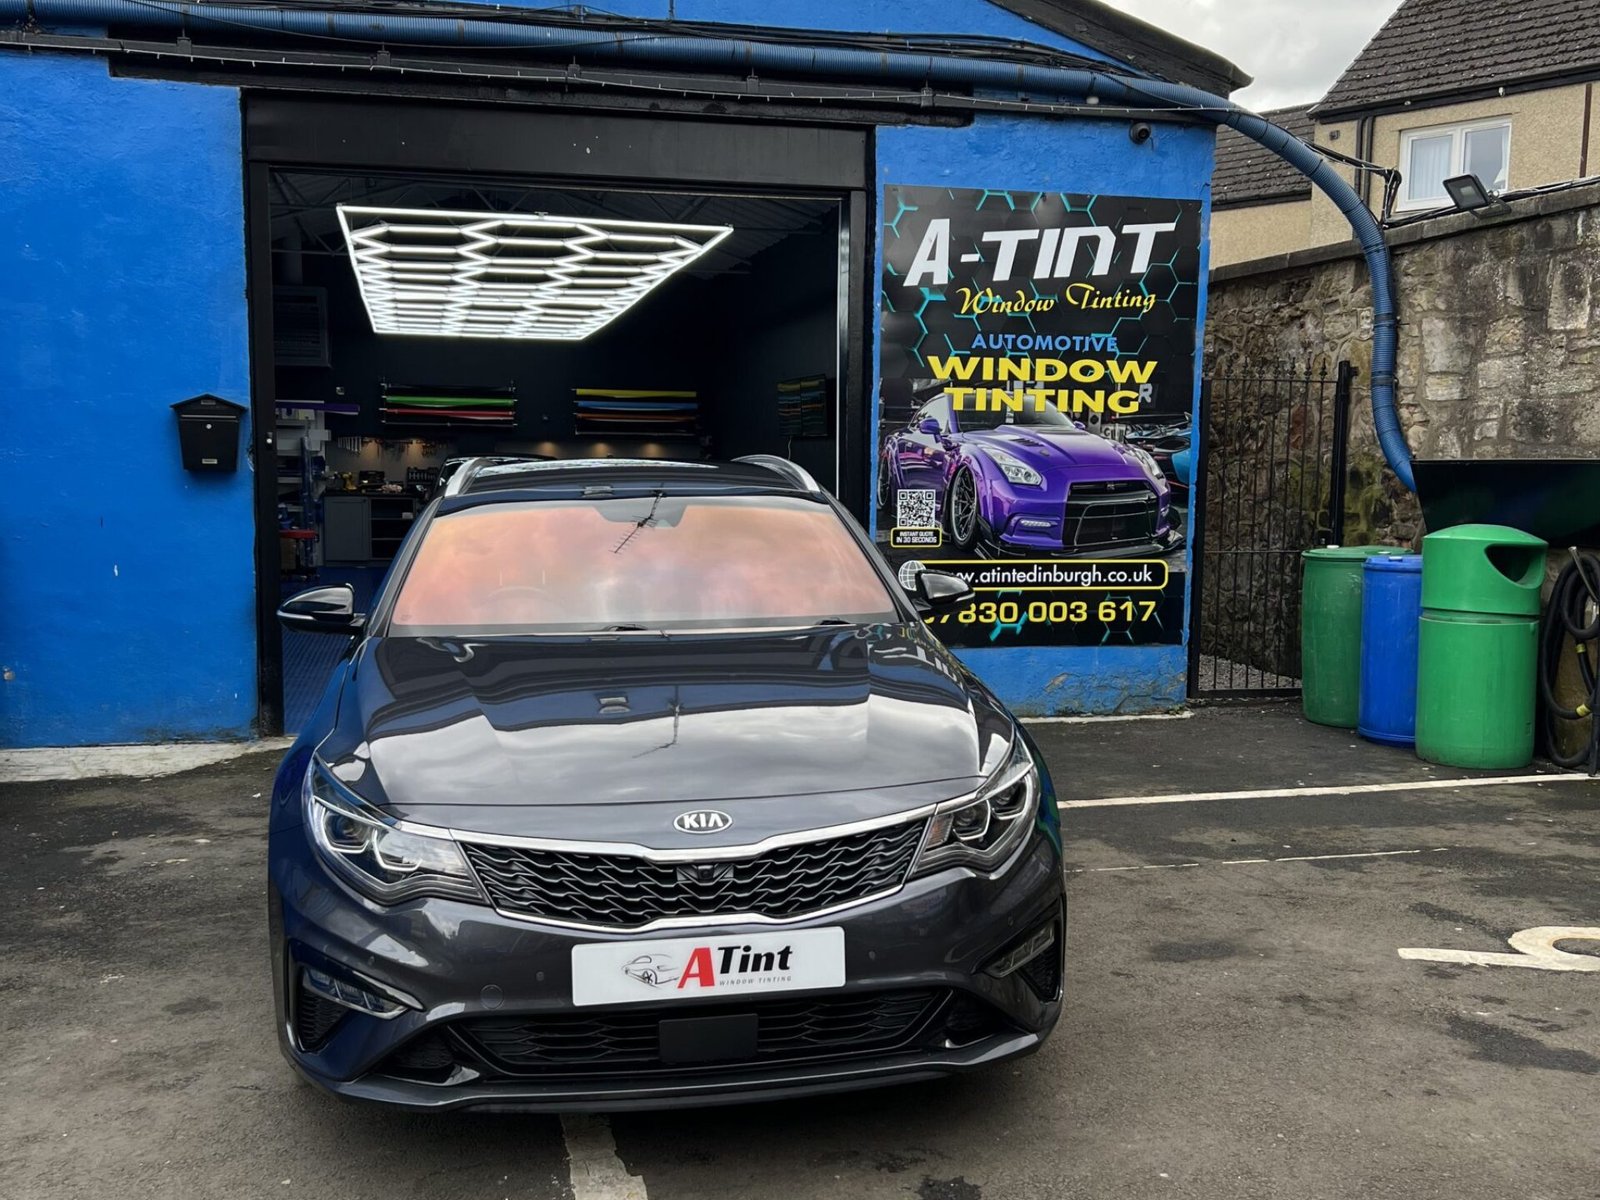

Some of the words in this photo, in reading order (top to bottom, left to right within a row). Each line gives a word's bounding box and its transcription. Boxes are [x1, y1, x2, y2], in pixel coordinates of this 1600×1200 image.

[956, 287, 1055, 314] Window
[1065, 283, 1156, 313] Tinting
[971, 333, 1118, 352] AUTOMOTIVE
[927, 355, 1158, 384] WINDOW
[943, 387, 1140, 414] TINTING
[956, 564, 1153, 587] w.atintedinburgh.co.uk
[924, 602, 1018, 624] 830
[1028, 601, 1088, 623] 003
[1098, 601, 1156, 622] 617
[683, 813, 724, 829] KIA
[719, 978, 754, 986] WINDOW
[758, 975, 792, 983] TINTING
